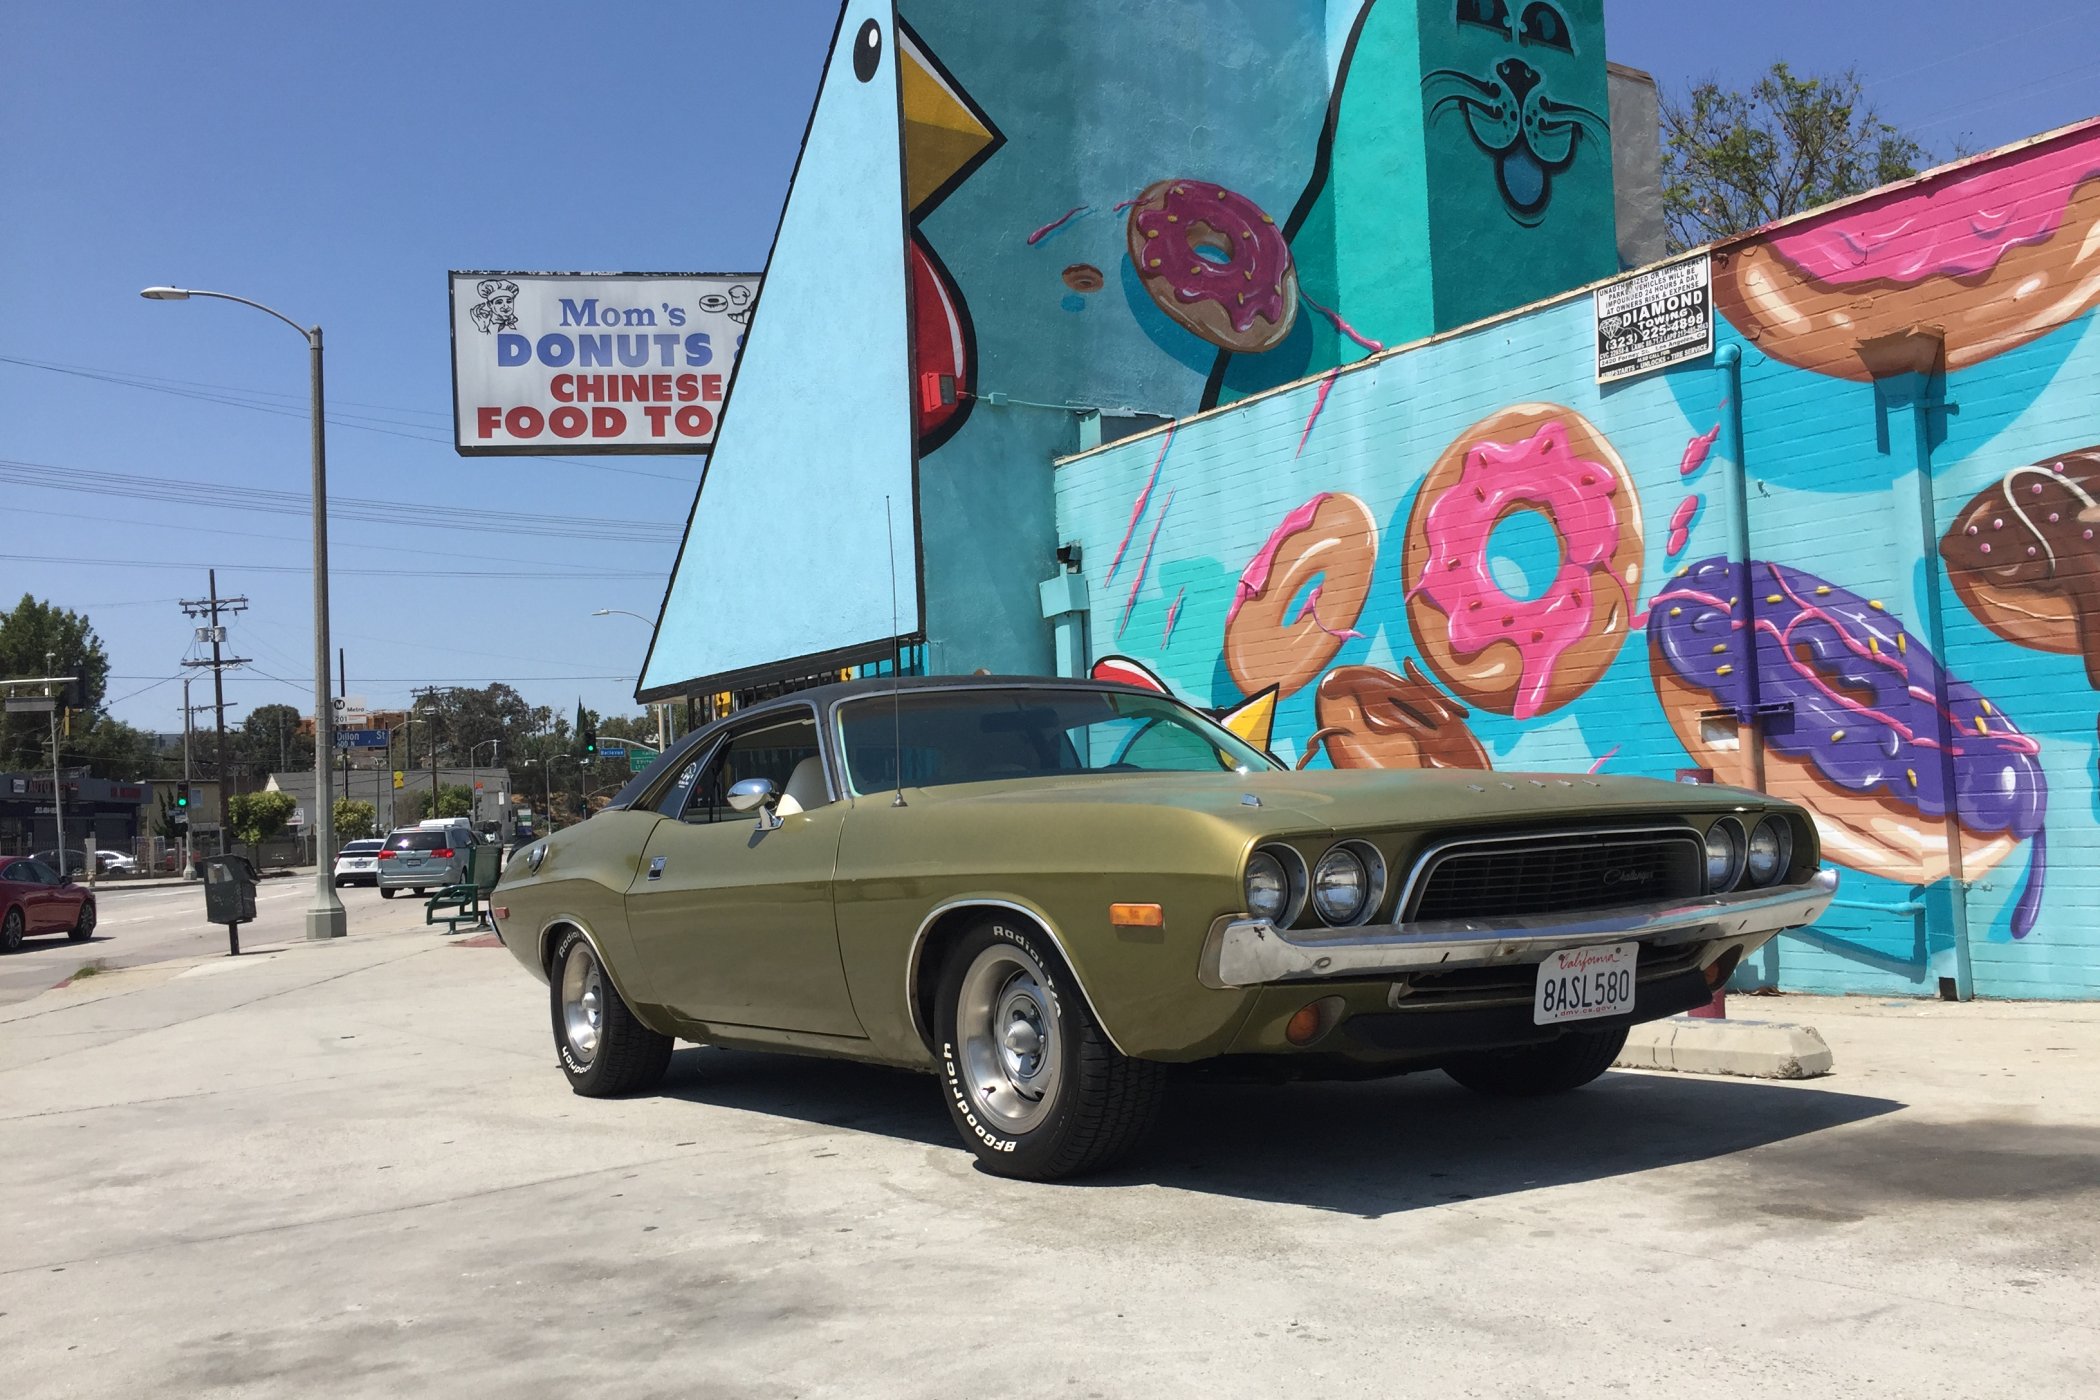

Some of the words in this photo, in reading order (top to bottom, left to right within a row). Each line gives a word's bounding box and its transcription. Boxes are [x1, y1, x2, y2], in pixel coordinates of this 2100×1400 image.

[1650, 271, 1659, 279] OR
[1662, 256, 1703, 276] IMPROPERLY
[1608, 286, 1632, 300] PARKE
[1634, 275, 1666, 292] VEHICLES
[1668, 269, 1683, 281] WILL
[1686, 266, 1694, 274] BE
[1616, 298, 1642, 312] OWNERS
[1644, 292, 1659, 303] RISK
[1669, 280, 1699, 295] EXPENSE
[1644, 287, 1652, 296] 24
[1654, 279, 1677, 292] HOURS
[1686, 272, 1698, 282] DAY
[558, 298, 687, 327] Mom's
[1622, 289, 1702, 326] DIAMOND
[1637, 307, 1687, 330] TOWING
[1605, 332, 1637, 351] (323)
[1642, 311, 1703, 340] 225-4898
[497, 332, 713, 368] DONUTS
[1684, 343, 1707, 356] SERVICE
[550, 373, 722, 403] CHINESE
[477, 406, 627, 439] FOOD
[644, 405, 714, 438] TO
[336, 731, 360, 740] Dillon
[376, 730, 386, 740] St
[1603, 868, 1654, 886] Challenger
[993, 925, 1044, 968] Radial
[1559, 952, 1619, 972] California
[1544, 970, 1630, 1012] 8ASL580
[1560, 1005, 1612, 1016] dmv.ca.gov
[943, 1042, 1017, 1152] BFGoodrich
